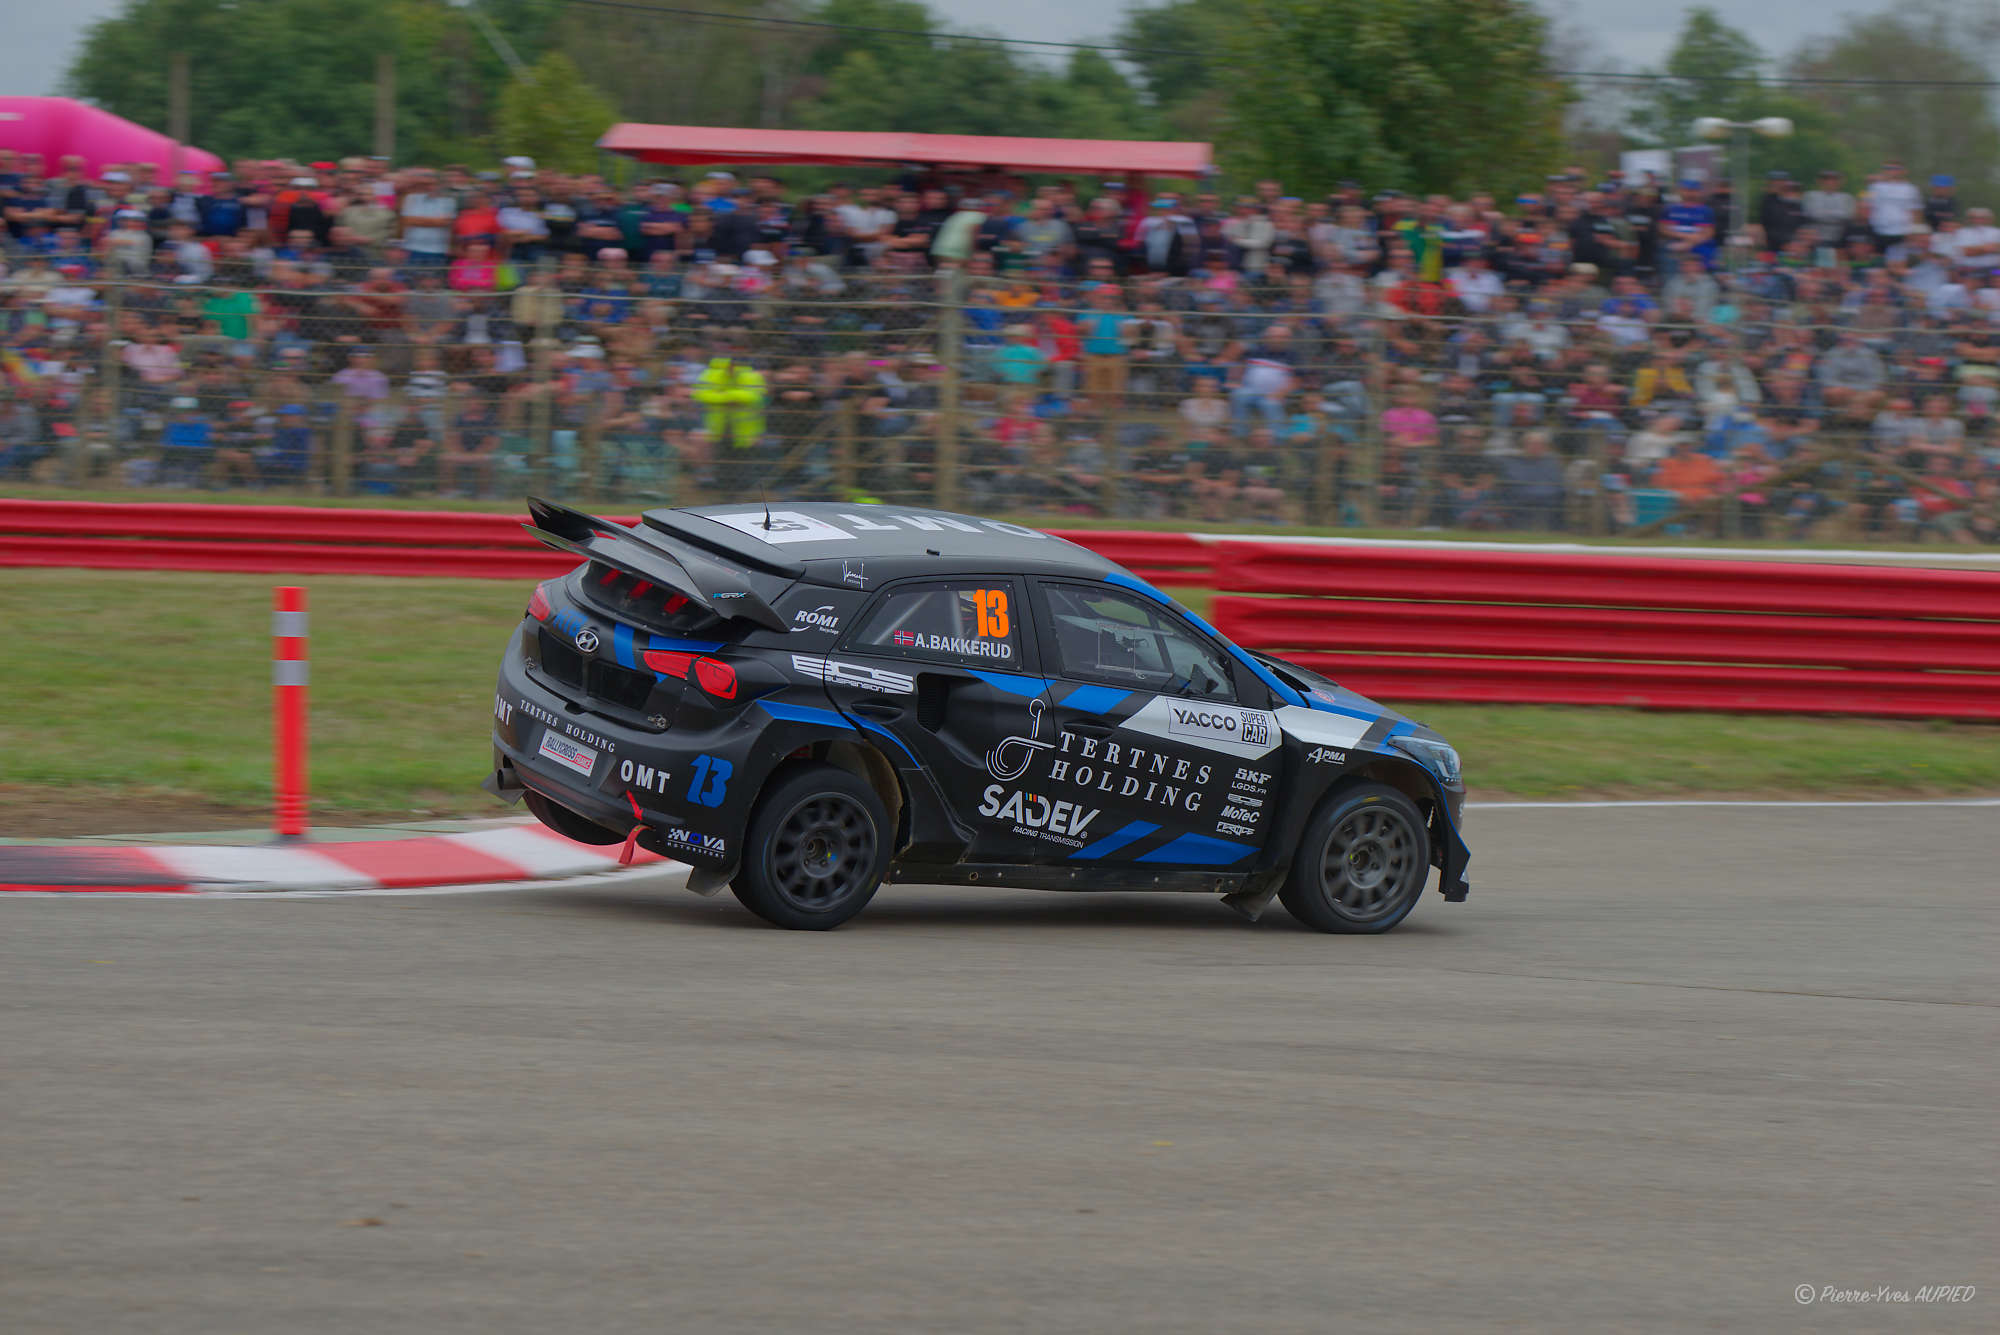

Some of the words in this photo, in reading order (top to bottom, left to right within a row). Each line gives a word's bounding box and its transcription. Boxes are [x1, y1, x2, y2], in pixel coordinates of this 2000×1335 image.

[795, 610, 839, 628] ROMI
[973, 589, 1009, 638] 13
[915, 633, 1012, 659] A.BAKKERUD
[520, 699, 558, 727] TERTNES
[565, 723, 616, 753] HOLDING
[1173, 708, 1236, 732] YACCO
[1240, 711, 1266, 725] SUPER
[1242, 725, 1267, 745] CAR
[1060, 731, 1212, 785] TERTNES
[1306, 747, 1345, 764] APMA
[620, 759, 671, 794] OMT
[686, 754, 734, 808] 13
[1048, 759, 1201, 812] HOLDING
[1235, 768, 1272, 784] SKF
[978, 784, 1100, 837] SADEV
[1221, 805, 1260, 823] MoTeC
[1013, 825, 1038, 837] RACING
[1039, 831, 1083, 849] TRANSMISSION
